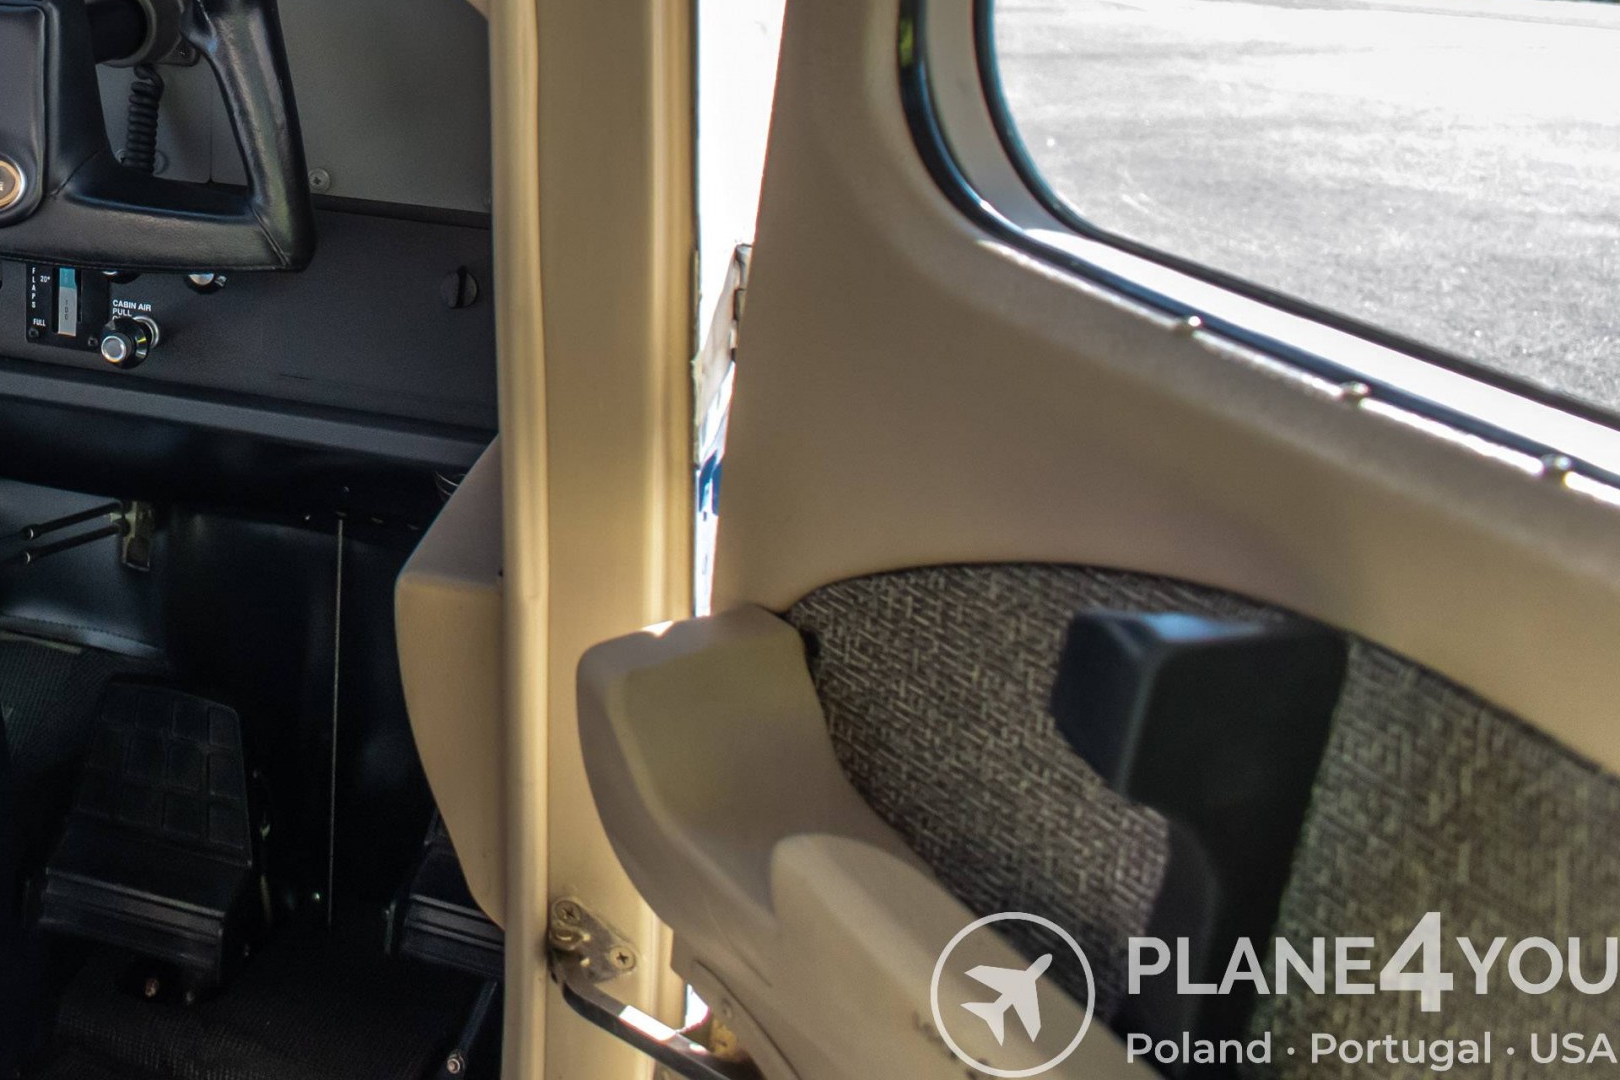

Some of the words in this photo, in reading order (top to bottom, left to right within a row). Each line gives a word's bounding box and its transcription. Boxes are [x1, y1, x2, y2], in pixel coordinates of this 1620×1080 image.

[112, 299, 137, 310] CABIN
[138, 303, 152, 312] AIR
[112, 307, 132, 317] PULL
[33, 318, 46, 327] FULL
